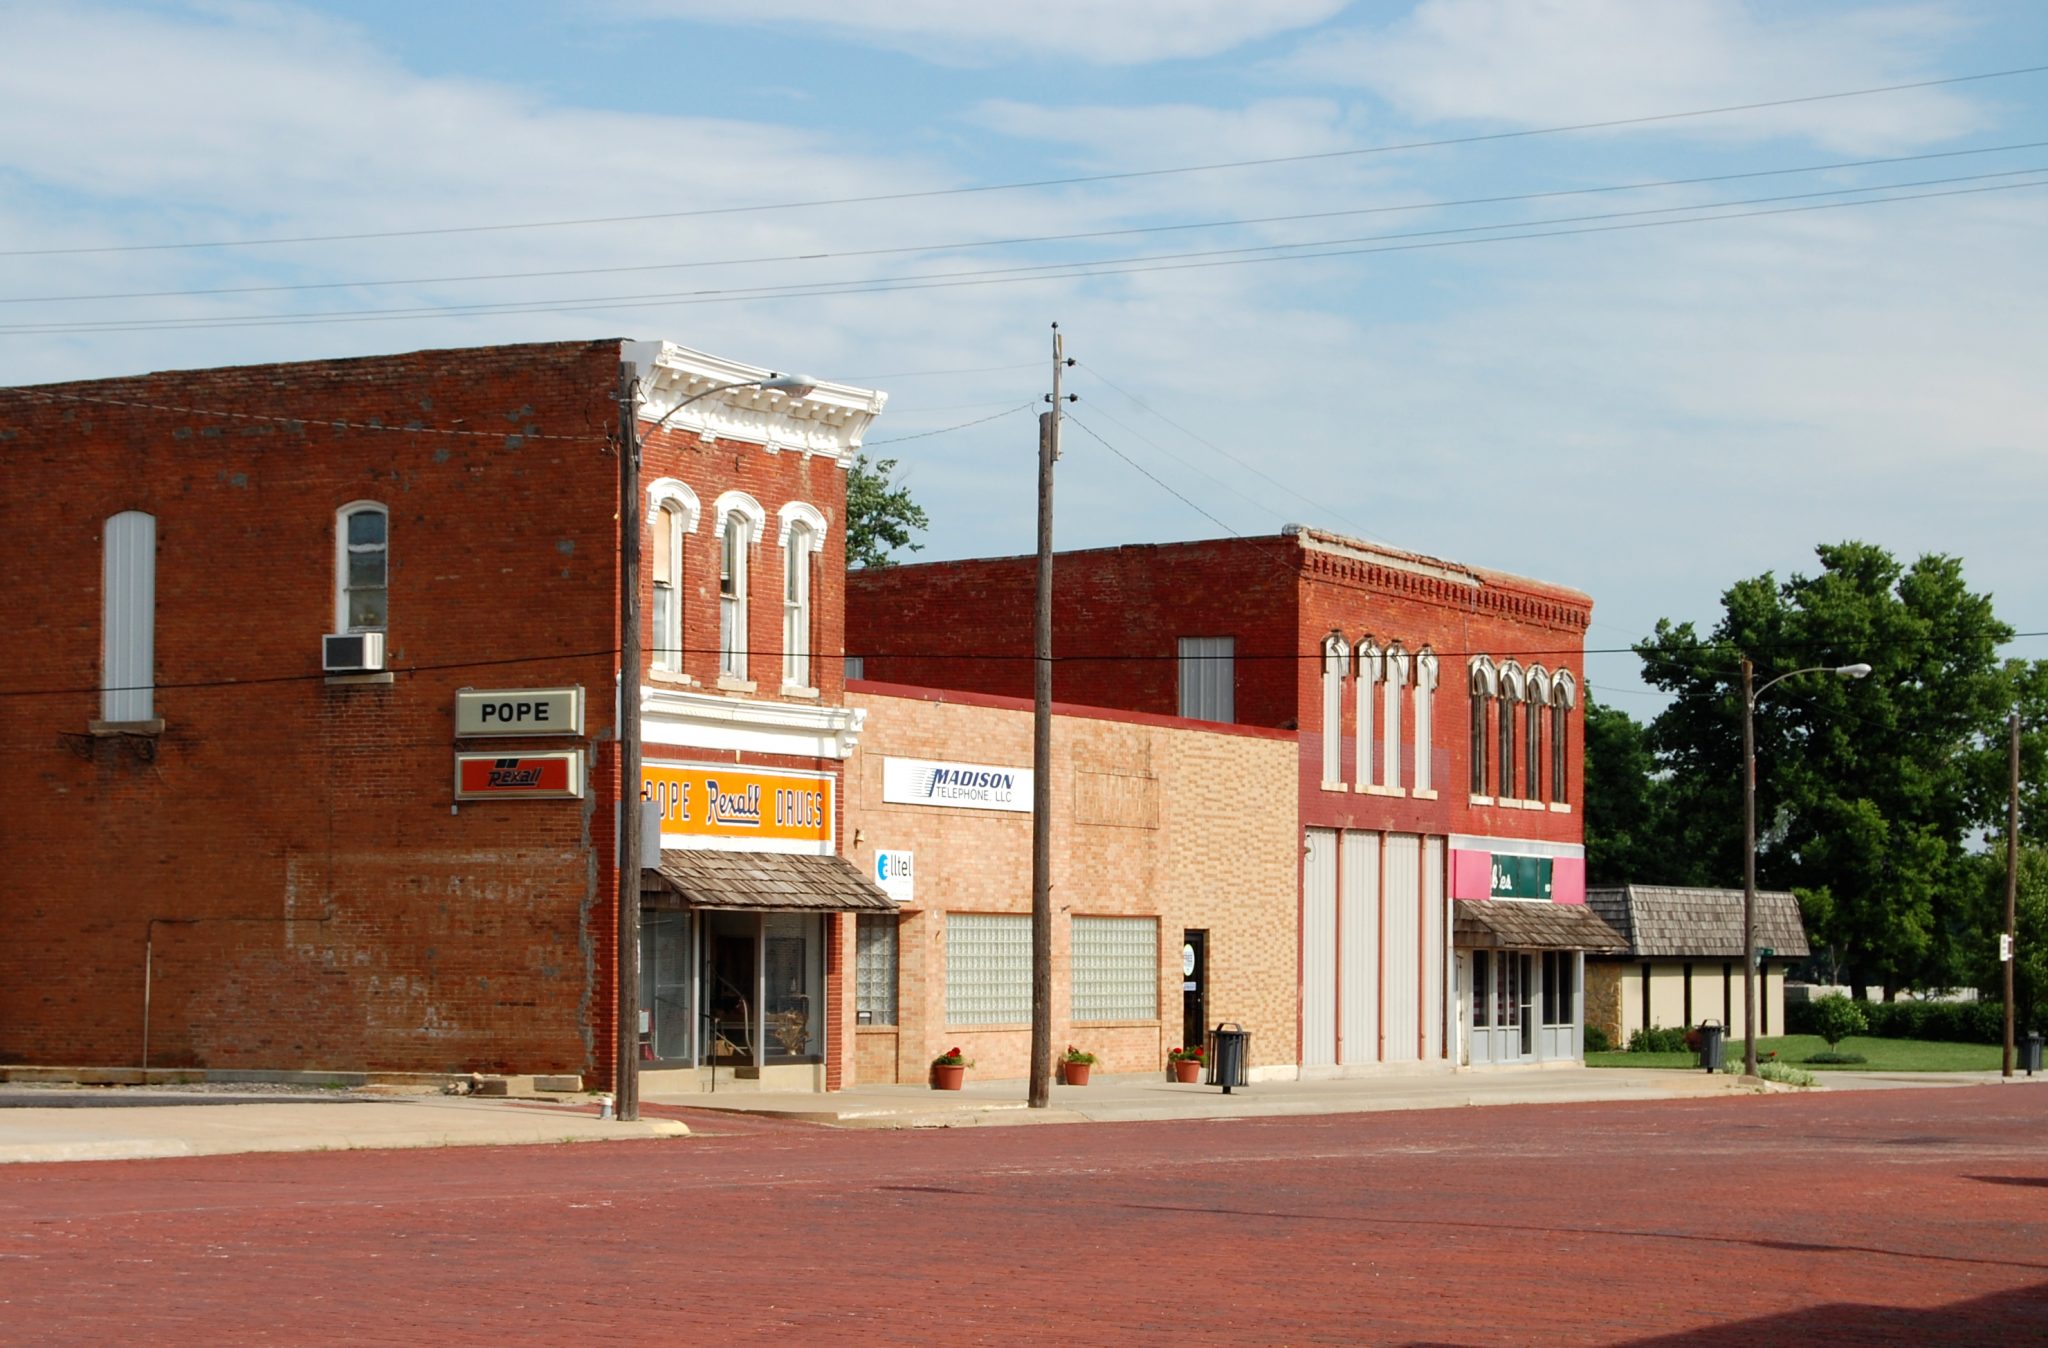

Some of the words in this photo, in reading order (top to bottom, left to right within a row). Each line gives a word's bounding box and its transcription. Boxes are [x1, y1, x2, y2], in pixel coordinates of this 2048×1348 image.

[482, 702, 549, 722] POPE
[488, 767, 543, 787] Rexall
[931, 768, 1014, 796] MADISON
[706, 780, 760, 826] Rexall
[776, 790, 823, 828] DRUGS
[995, 790, 1012, 802] LLC
